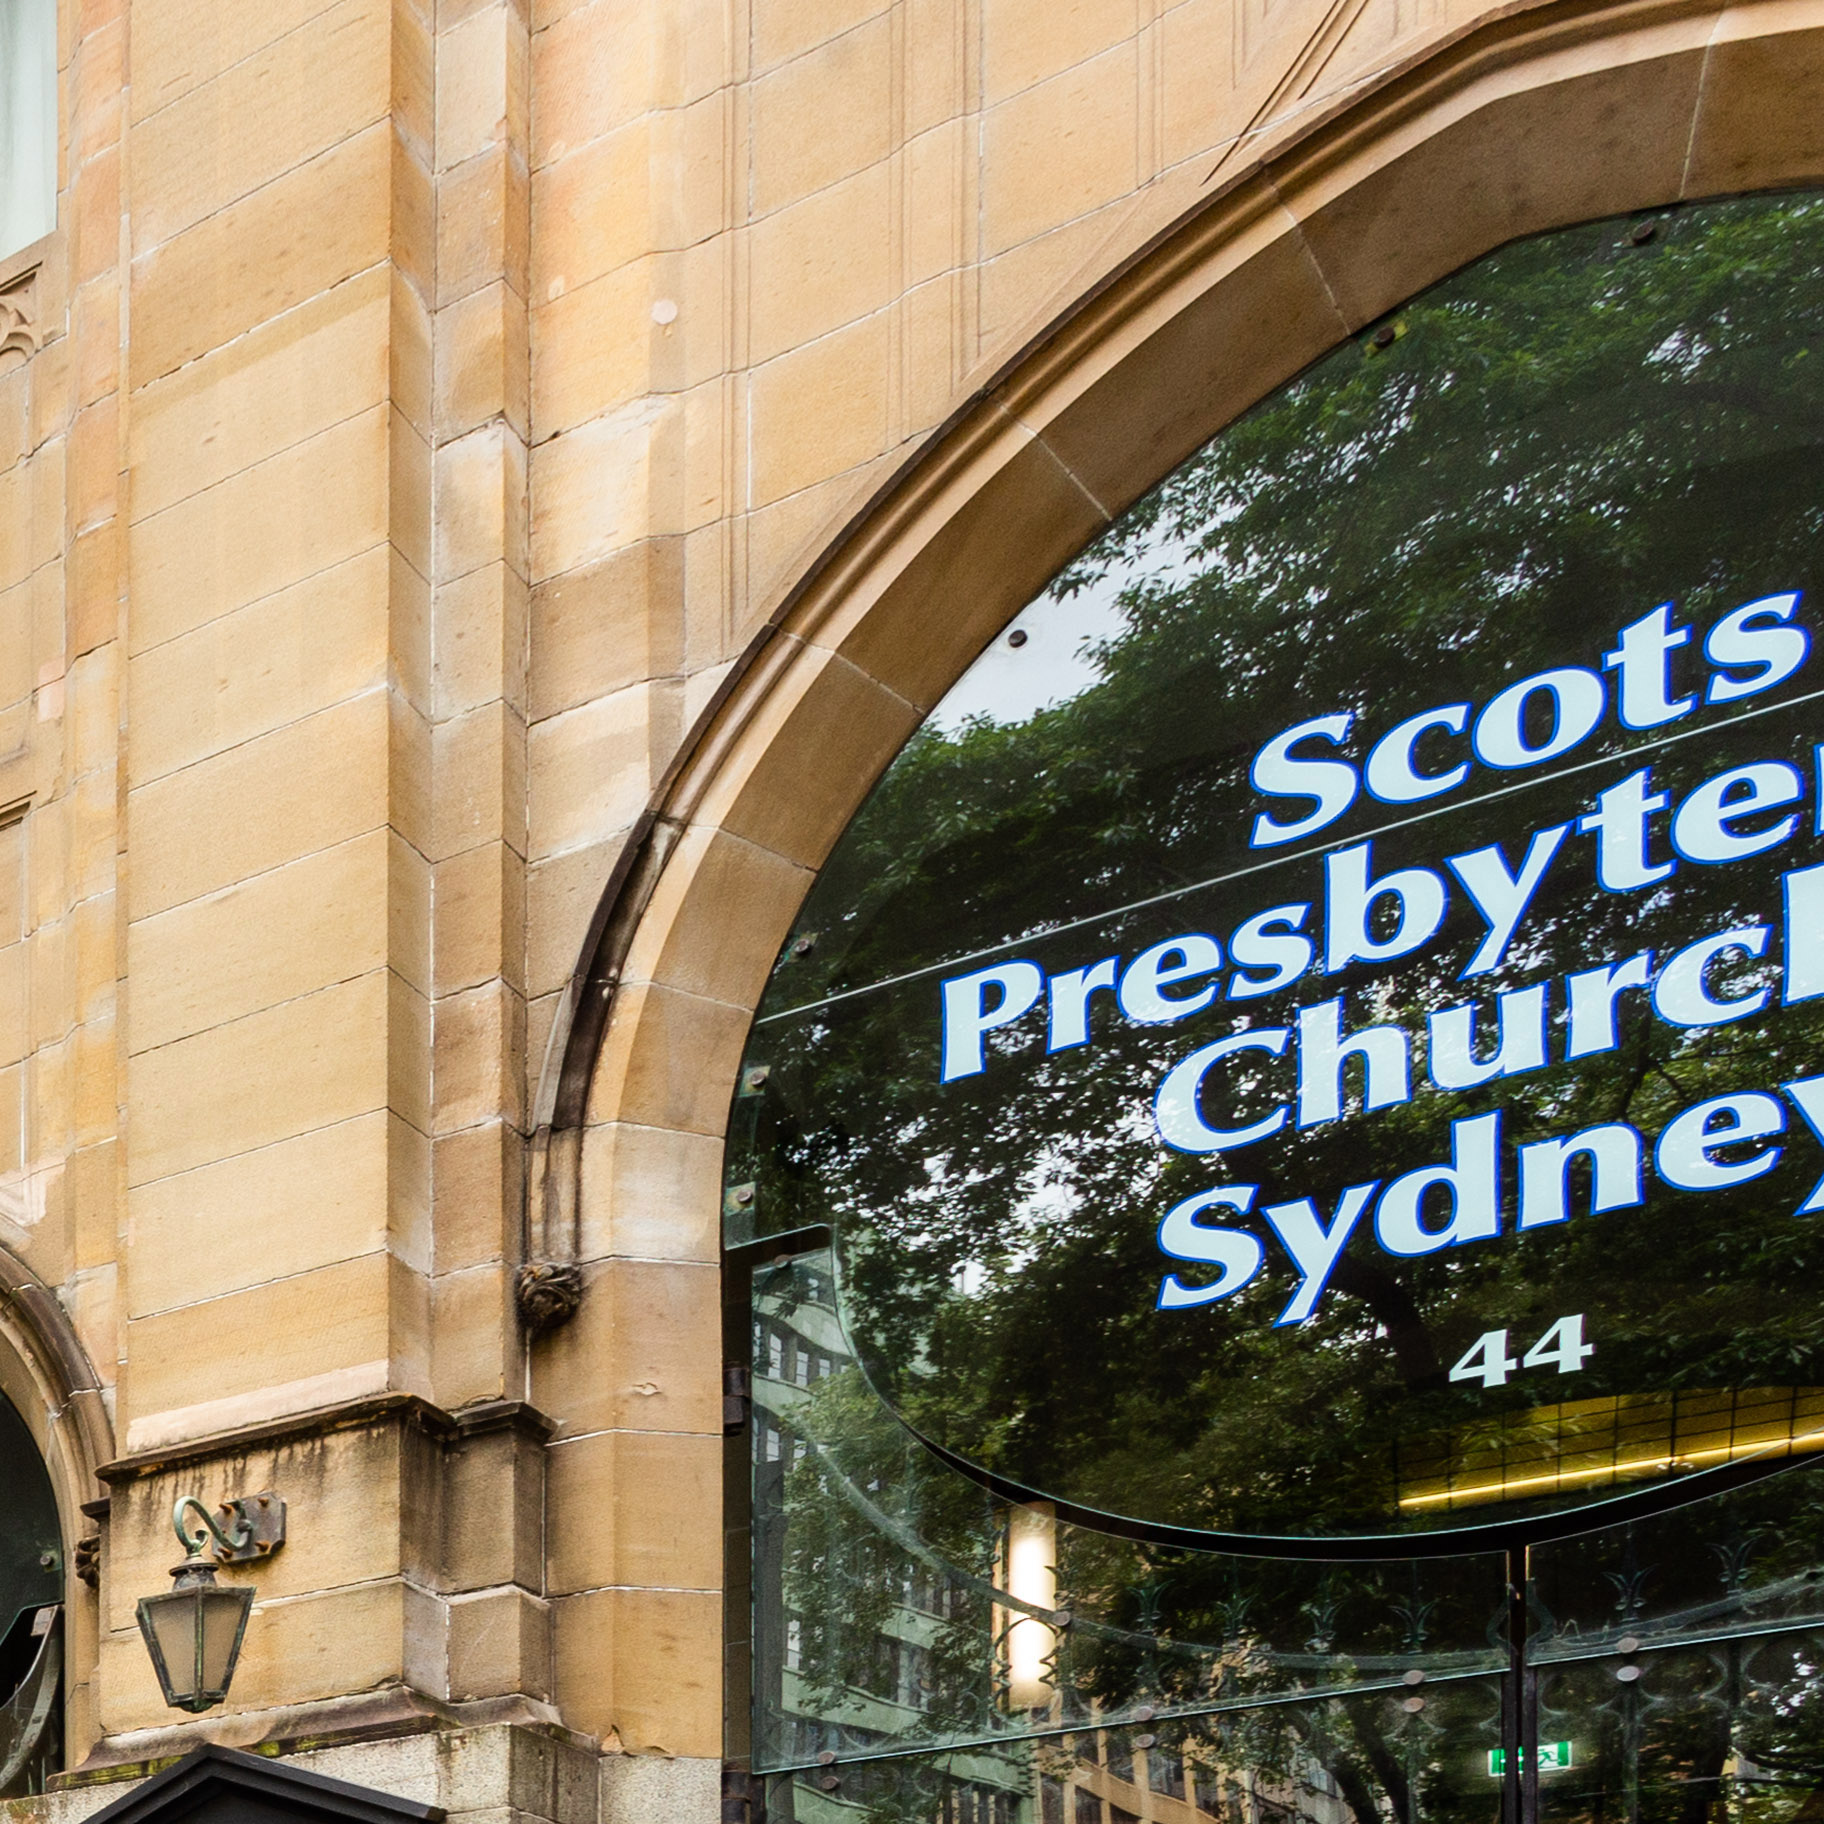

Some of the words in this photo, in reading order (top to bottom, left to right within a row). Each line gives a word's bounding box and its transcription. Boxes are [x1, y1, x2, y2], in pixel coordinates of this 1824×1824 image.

[1248, 589, 1809, 848] Scots
[940, 742, 1824, 1085] Presbyte
[1449, 1313, 1596, 1388] 44
